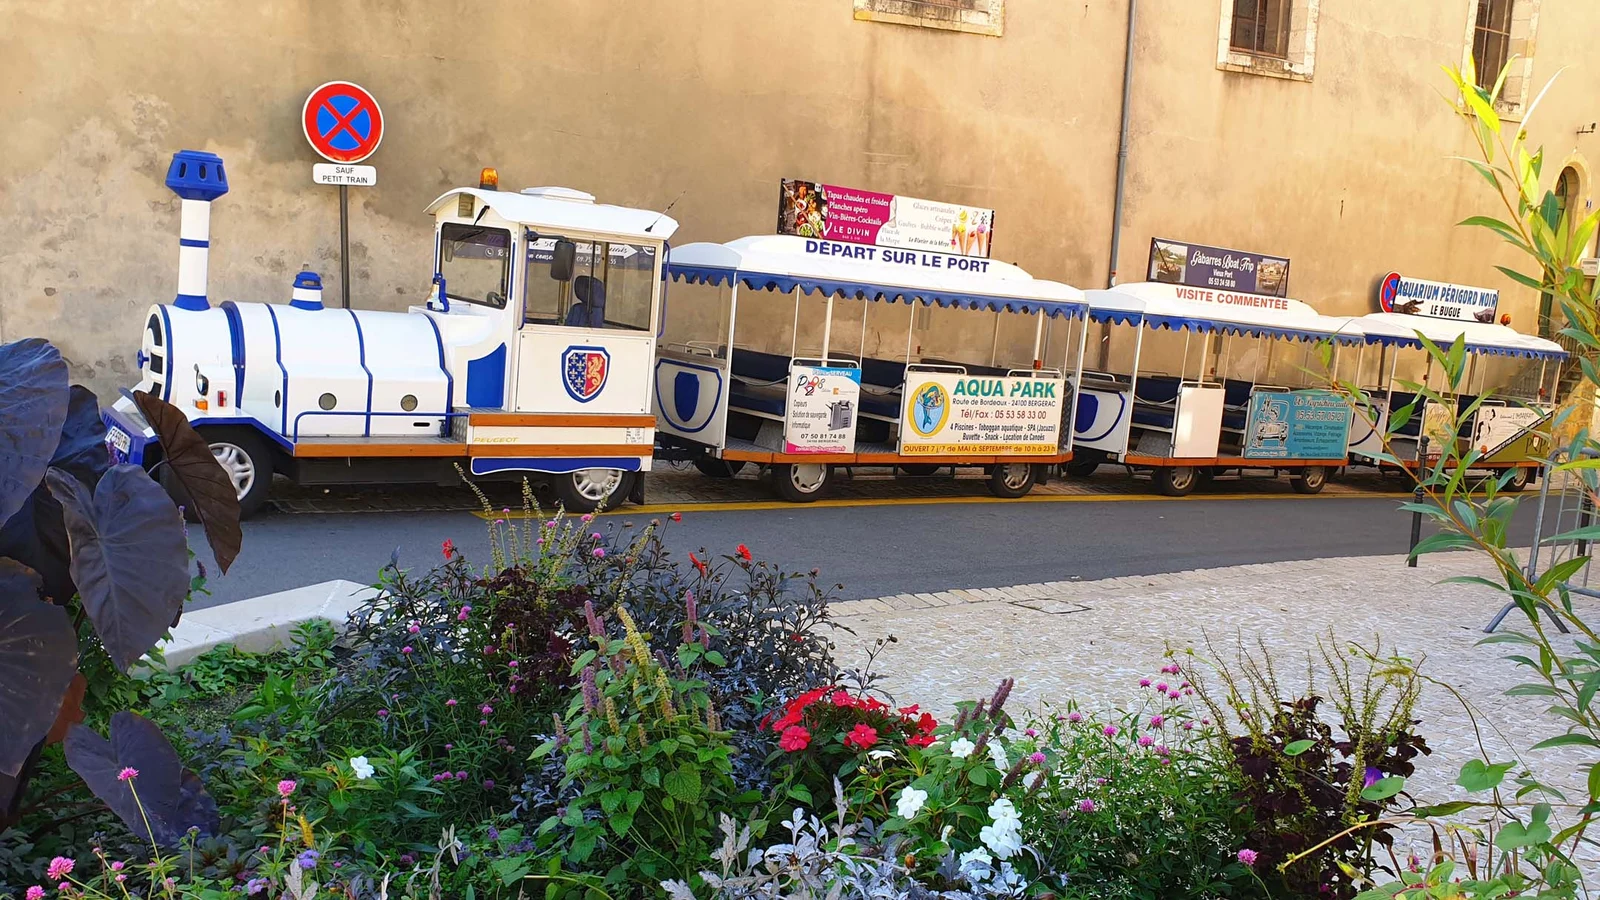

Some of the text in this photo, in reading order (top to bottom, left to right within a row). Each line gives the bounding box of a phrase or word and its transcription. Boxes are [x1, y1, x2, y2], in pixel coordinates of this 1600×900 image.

[347, 176, 368, 184] TRAIN
[827, 191, 842, 201] Tapas
[843, 193, 864, 203] chaudes
[871, 197, 889, 207] froides
[829, 201, 868, 214] Planches apéro
[828, 211, 882, 226] Vin-Bières-Cocktails
[834, 225, 870, 236] LE DIVIN
[805, 239, 990, 273] DÉPART SUR LE PORT
[1190, 250, 1254, 273] Gabarres Boat Trip
[1213, 268, 1233, 279] Vieux Port
[1208, 277, 1214, 285] 05
[1214, 278, 1220, 286] 53
[1220, 278, 1225, 287] 24
[1176, 287, 1289, 311] VISITE COMMENTÉE
[1396, 280, 1498, 308] AQUARIUM PÉRIGORD NOIR
[1430, 304, 1461, 318] LE BUGUE
[953, 379, 1056, 398] AQUA PARK
[980, 398, 1007, 406] Bordeaux
[1011, 399, 1027, 407] 24100
[961, 408, 989, 419] Tél/Fax
[994, 410, 1004, 419] 05
[1005, 410, 1015, 419] 53
[1016, 410, 1026, 420] 58
[1027, 411, 1036, 420] 33
[1037, 411, 1047, 420] 00
[954, 423, 974, 431] Piscines
[978, 423, 1000, 432] Toboggan
[1001, 424, 1023, 433] aquatique
[1027, 424, 1036, 432] SPA
[1036, 424, 1056, 433] (Jacuzzi)
[962, 433, 980, 441] Buvette
[985, 433, 999, 441] Snack
[1003, 433, 1022, 441] Location
[1023, 433, 1028, 441] de
[903, 445, 929, 453] OUVERT
[971, 445, 977, 453] à
